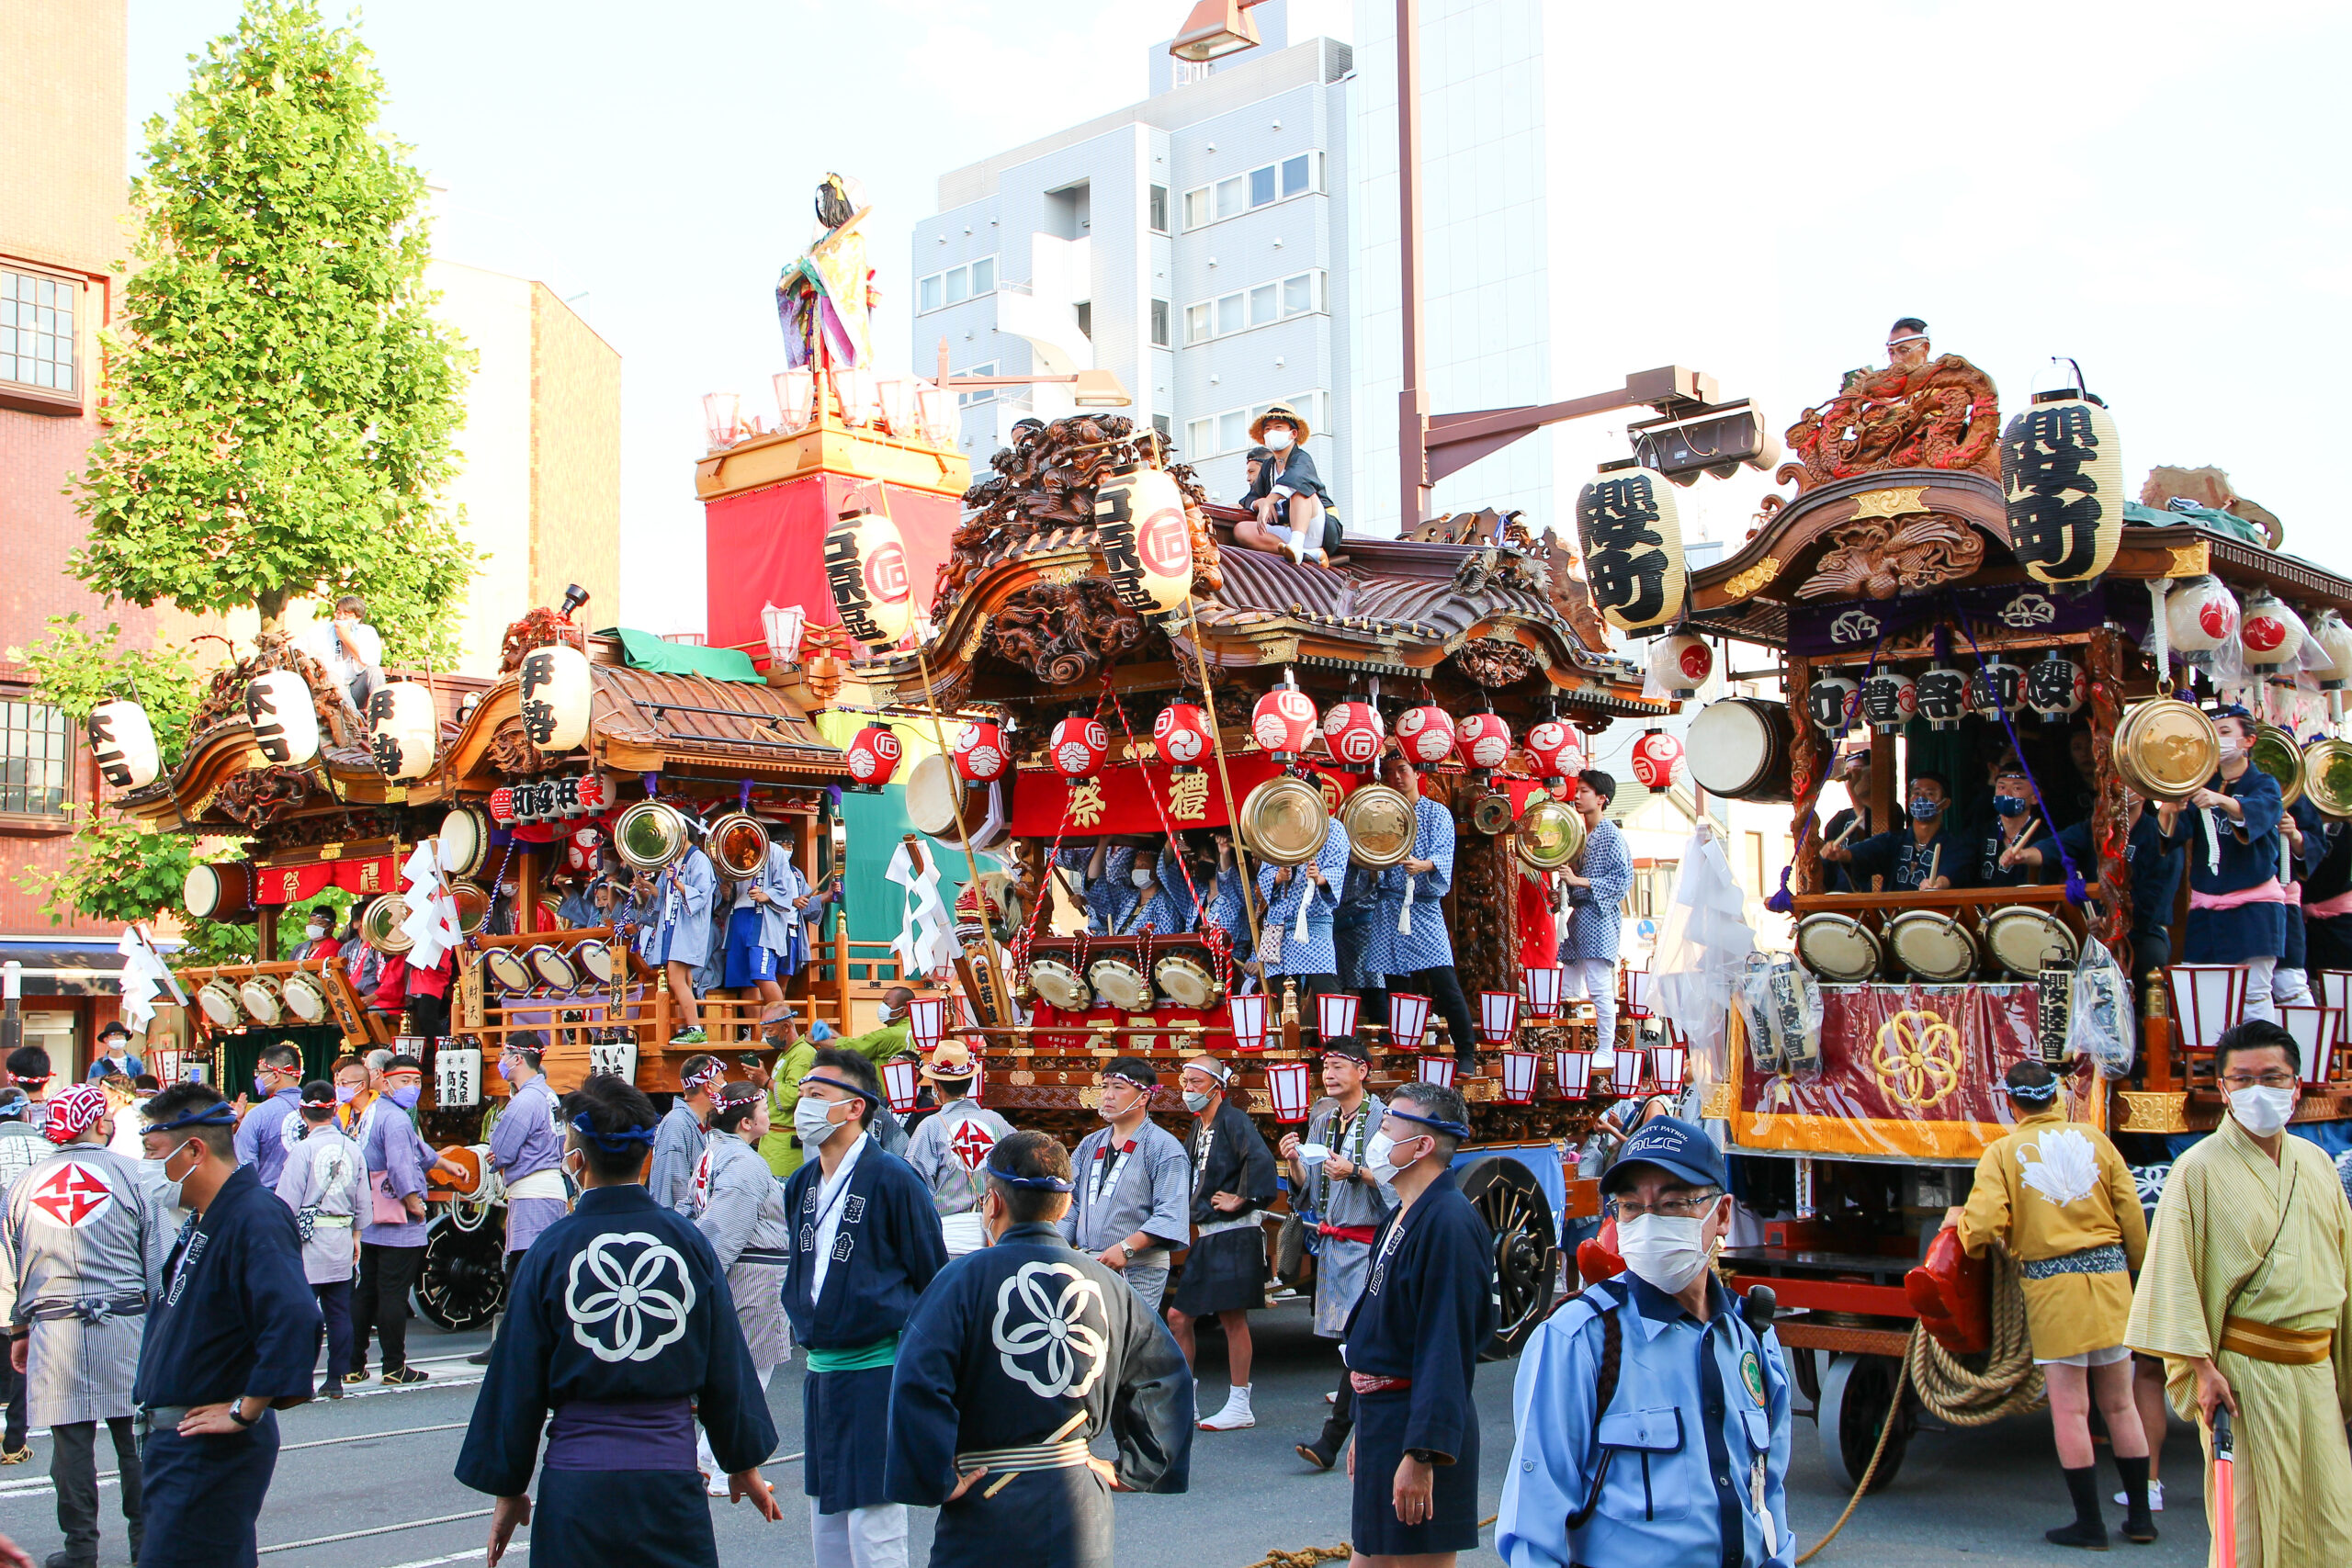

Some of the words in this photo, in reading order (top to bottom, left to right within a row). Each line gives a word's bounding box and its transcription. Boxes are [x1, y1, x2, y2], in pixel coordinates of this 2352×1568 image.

[1577, 473, 1668, 622] 櫻町
[2002, 405, 2099, 579] 櫻町
[1661, 1126, 1688, 1142] PATROL
